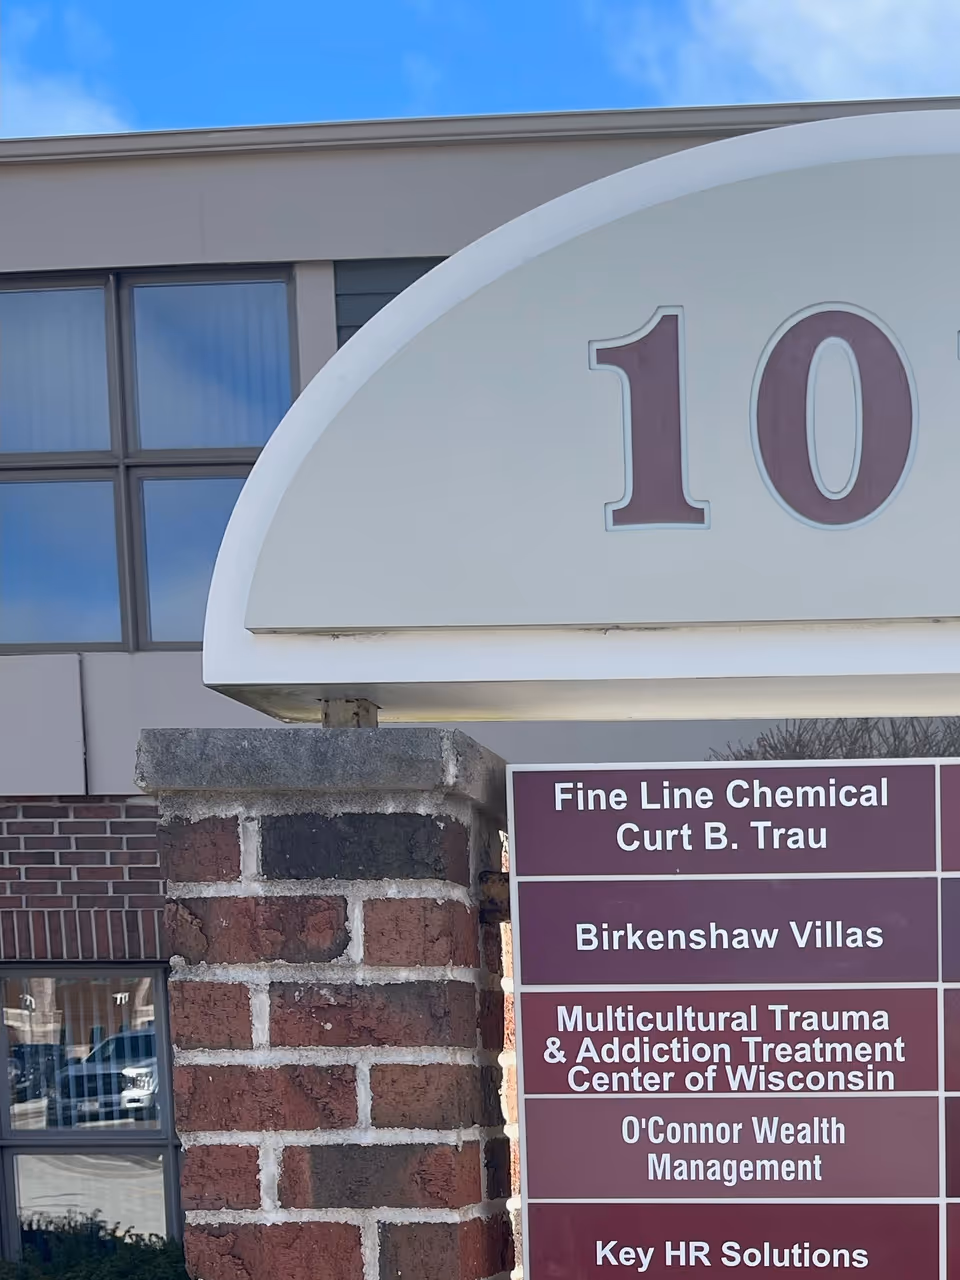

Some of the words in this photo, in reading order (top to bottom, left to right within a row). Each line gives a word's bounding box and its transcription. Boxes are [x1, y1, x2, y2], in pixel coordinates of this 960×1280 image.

[555, 783, 627, 810] Fine
[641, 781, 713, 809] Line
[727, 778, 887, 808] Chemical
[617, 823, 692, 851] Curt
[705, 822, 737, 849] B.
[750, 821, 826, 848] Trau
[577, 923, 778, 950] Birkenshaw
[790, 921, 883, 947] Villas
[558, 1005, 756, 1031] Multicultural
[768, 1005, 889, 1030] Trauma
[544, 1037, 566, 1063] &
[576, 1037, 730, 1063] Addiction
[742, 1037, 905, 1062] Treatment
[568, 1066, 675, 1091] Center
[685, 1065, 717, 1091] of
[725, 1064, 894, 1090] Wisconsin
[622, 1116, 742, 1143] O'Connor
[752, 1117, 844, 1143] Wealth
[648, 1154, 821, 1186] Management
[597, 1241, 654, 1272] Key
[666, 1242, 711, 1266] HR
[721, 1242, 868, 1267] Solutions
